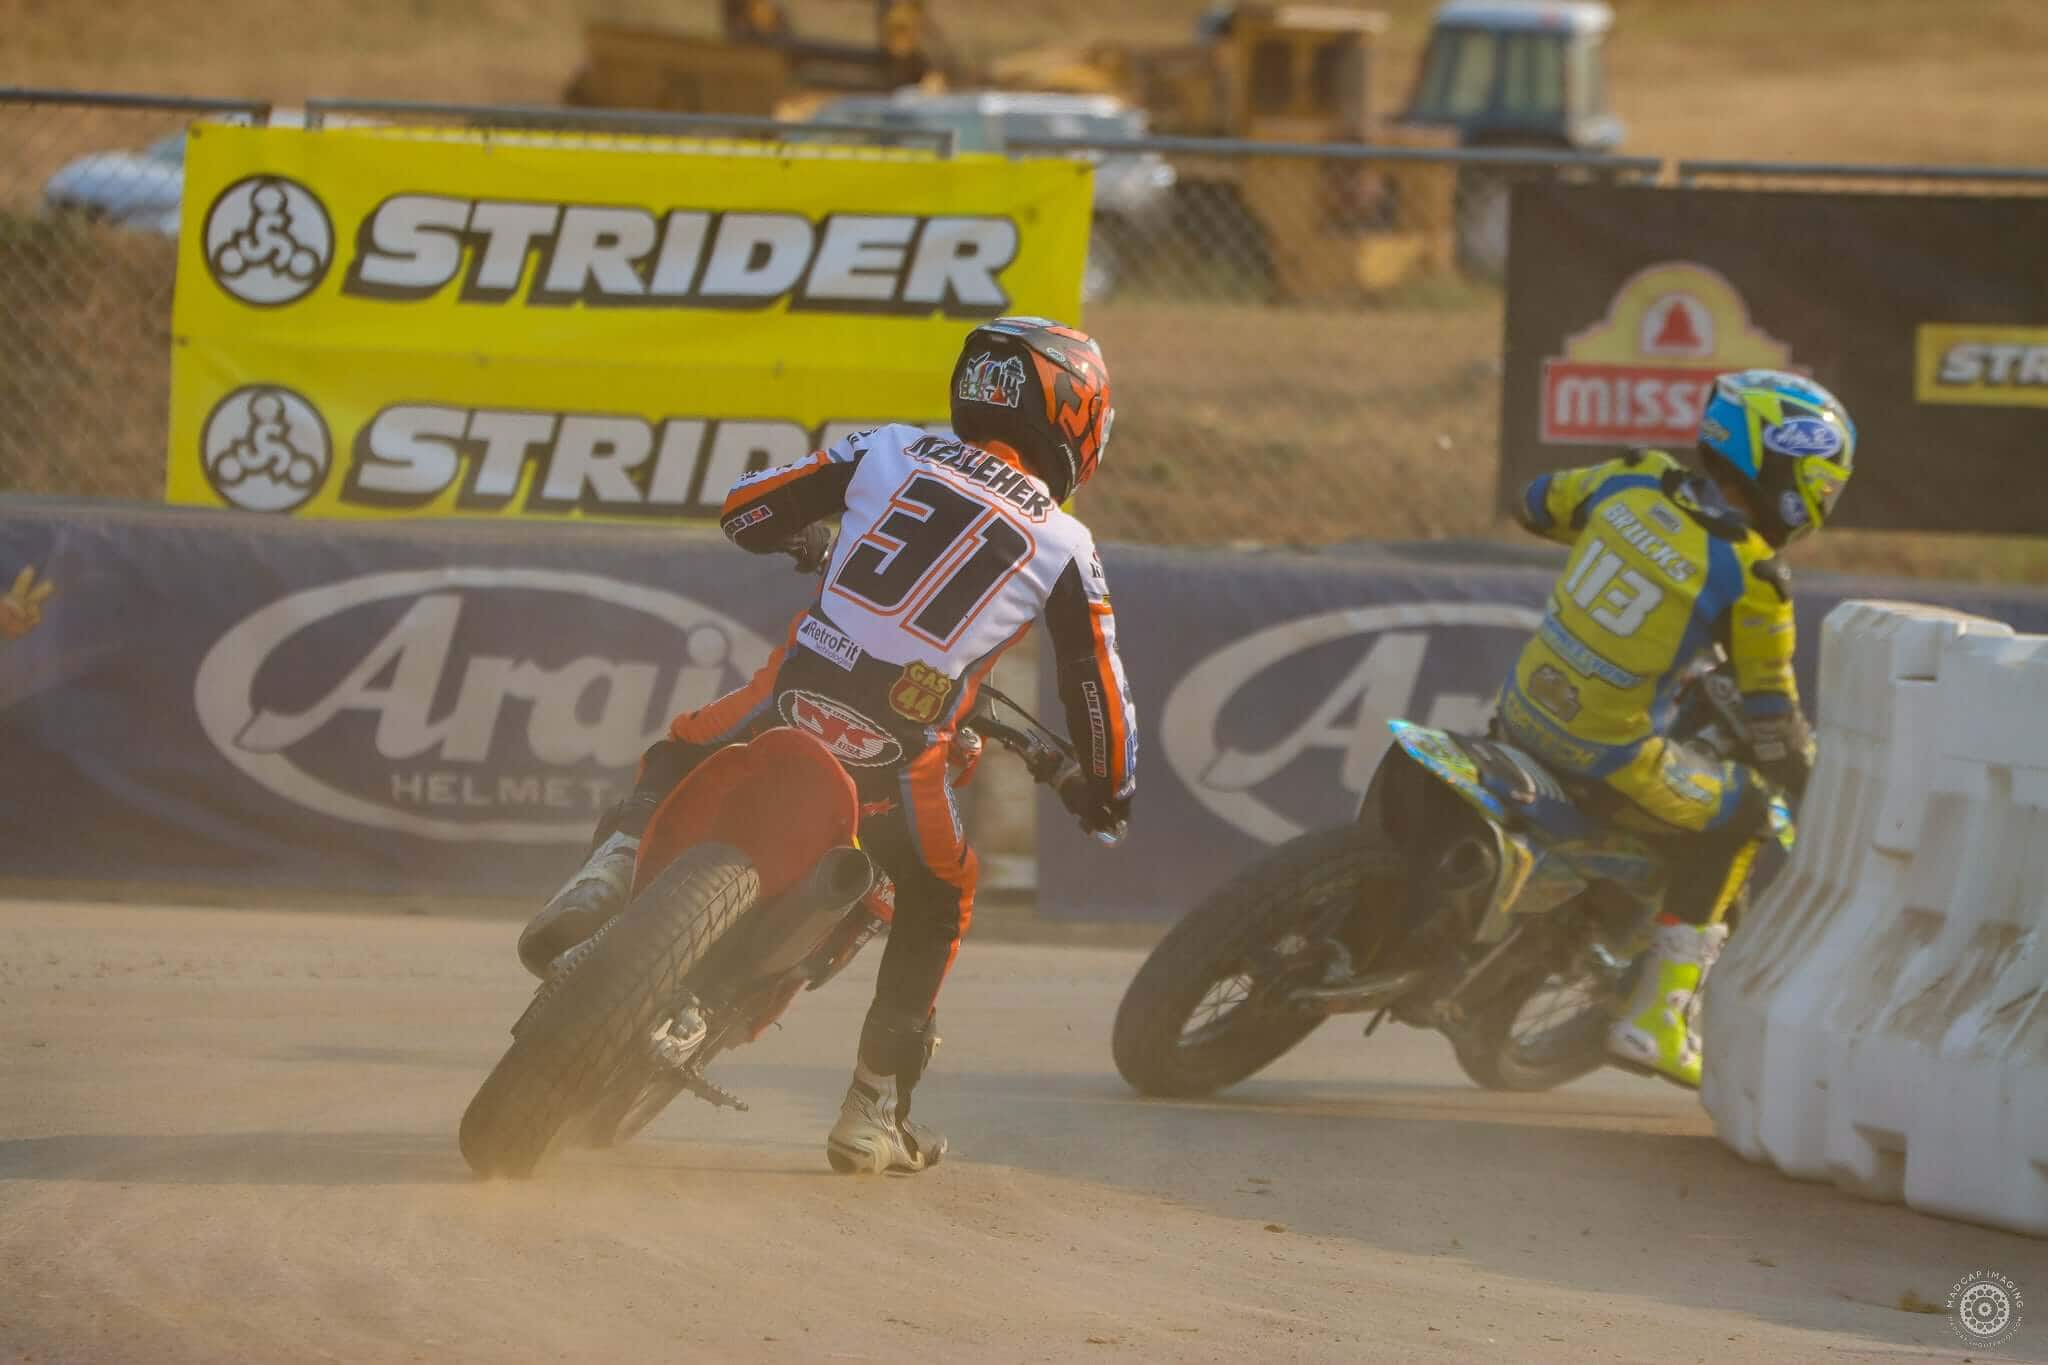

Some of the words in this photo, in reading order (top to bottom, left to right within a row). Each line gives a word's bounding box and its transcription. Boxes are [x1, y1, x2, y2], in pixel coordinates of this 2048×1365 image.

[341, 190, 1016, 316] STRIDER
[1555, 376, 1712, 428] MISS
[339, 404, 953, 514] STRID
[832, 472, 1034, 648] 31
[1566, 539, 1663, 635] 113
[234, 595, 728, 768] Arai
[807, 620, 859, 662] RetroFit
[910, 662, 949, 692] GAS
